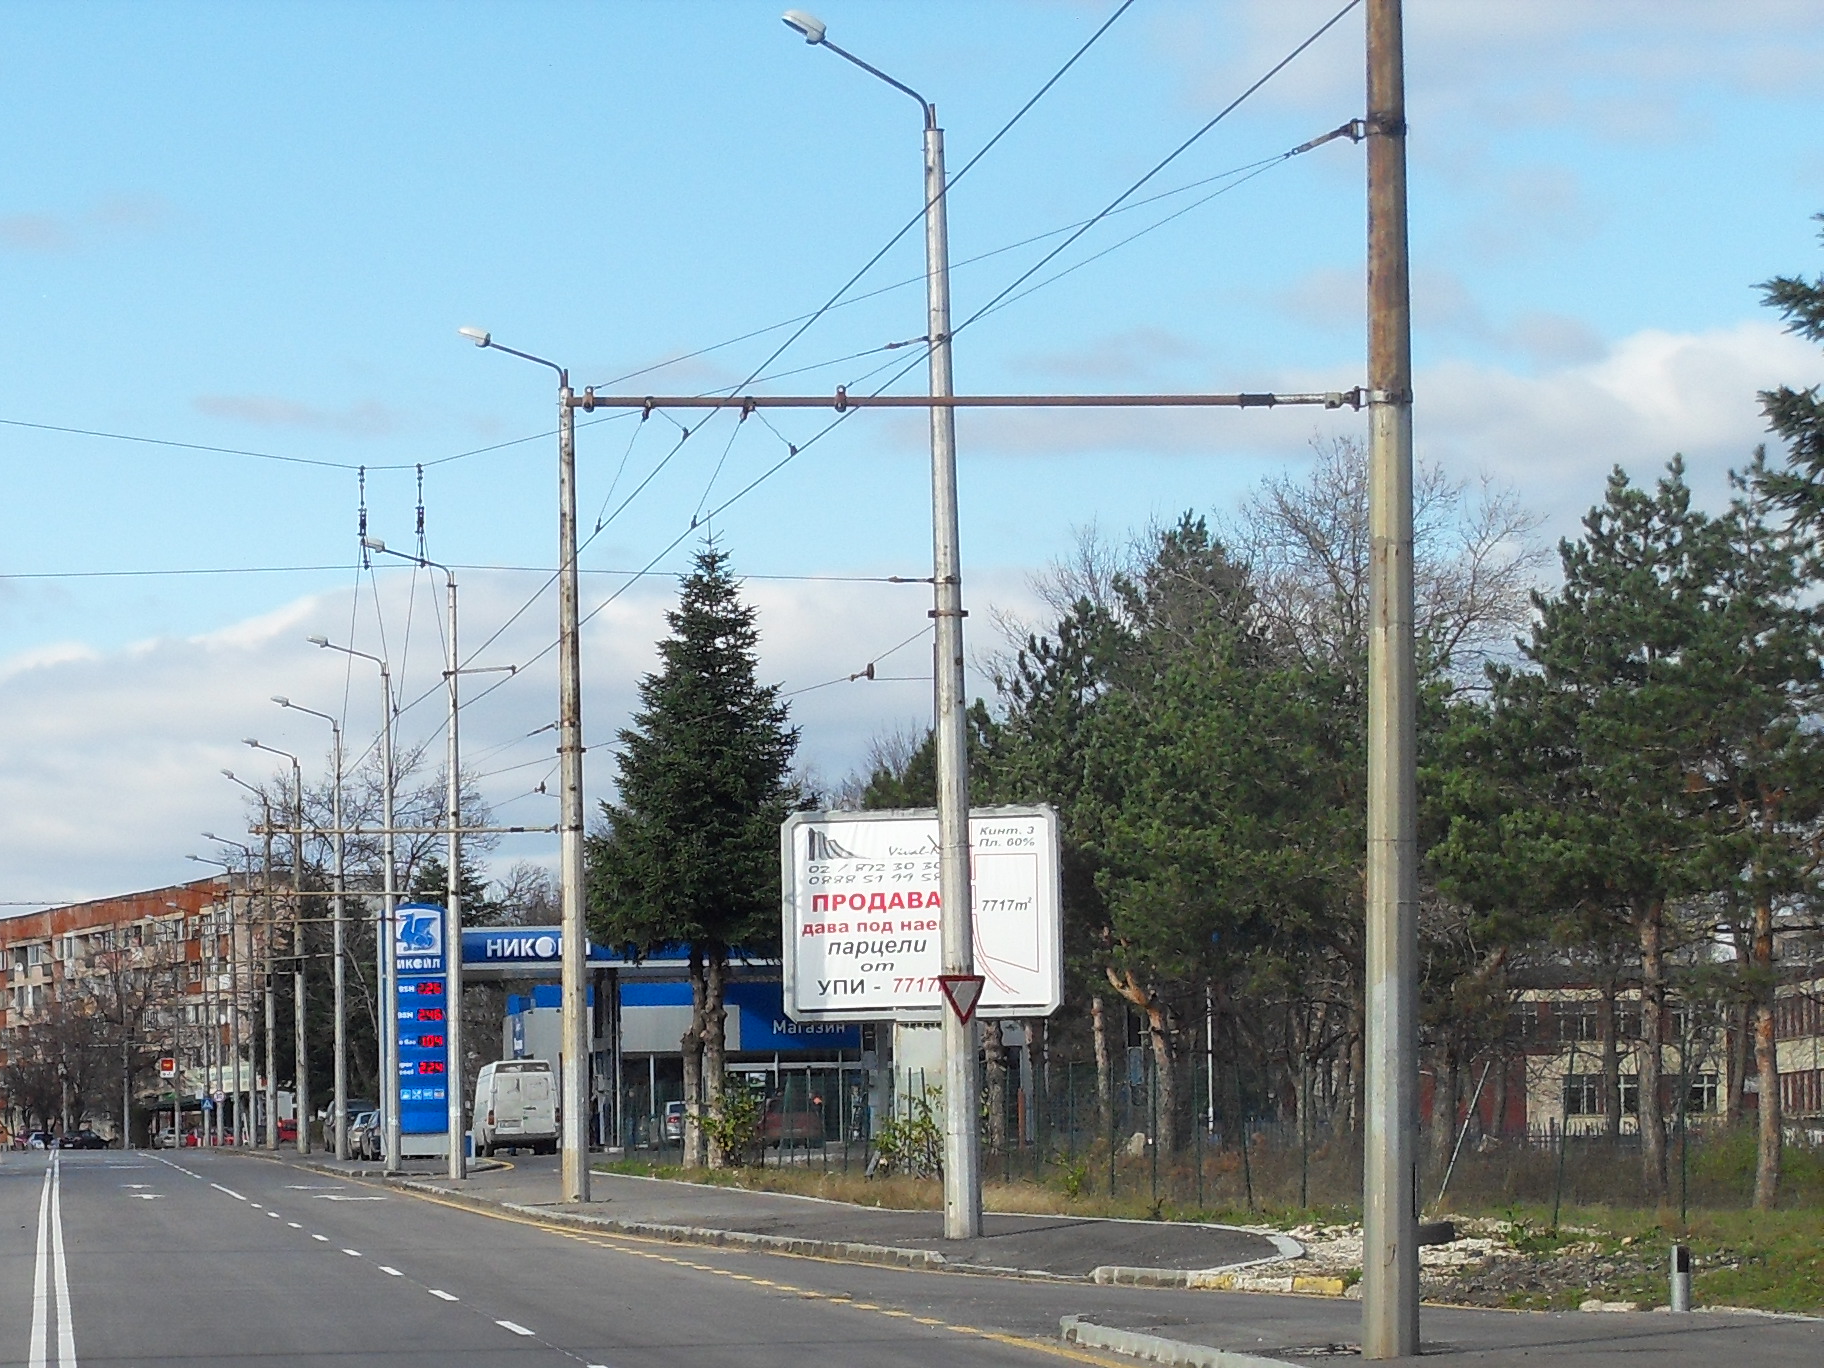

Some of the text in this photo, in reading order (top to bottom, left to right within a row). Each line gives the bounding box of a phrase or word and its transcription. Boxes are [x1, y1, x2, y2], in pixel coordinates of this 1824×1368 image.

[808, 865, 831, 874] 02
[812, 891, 942, 913] ПРОДАВА
[802, 919, 942, 937] дава под нае
[486, 936, 592, 957] НИКО
[828, 939, 927, 959] парцели
[860, 962, 895, 972] от
[817, 979, 865, 996] УПИ
